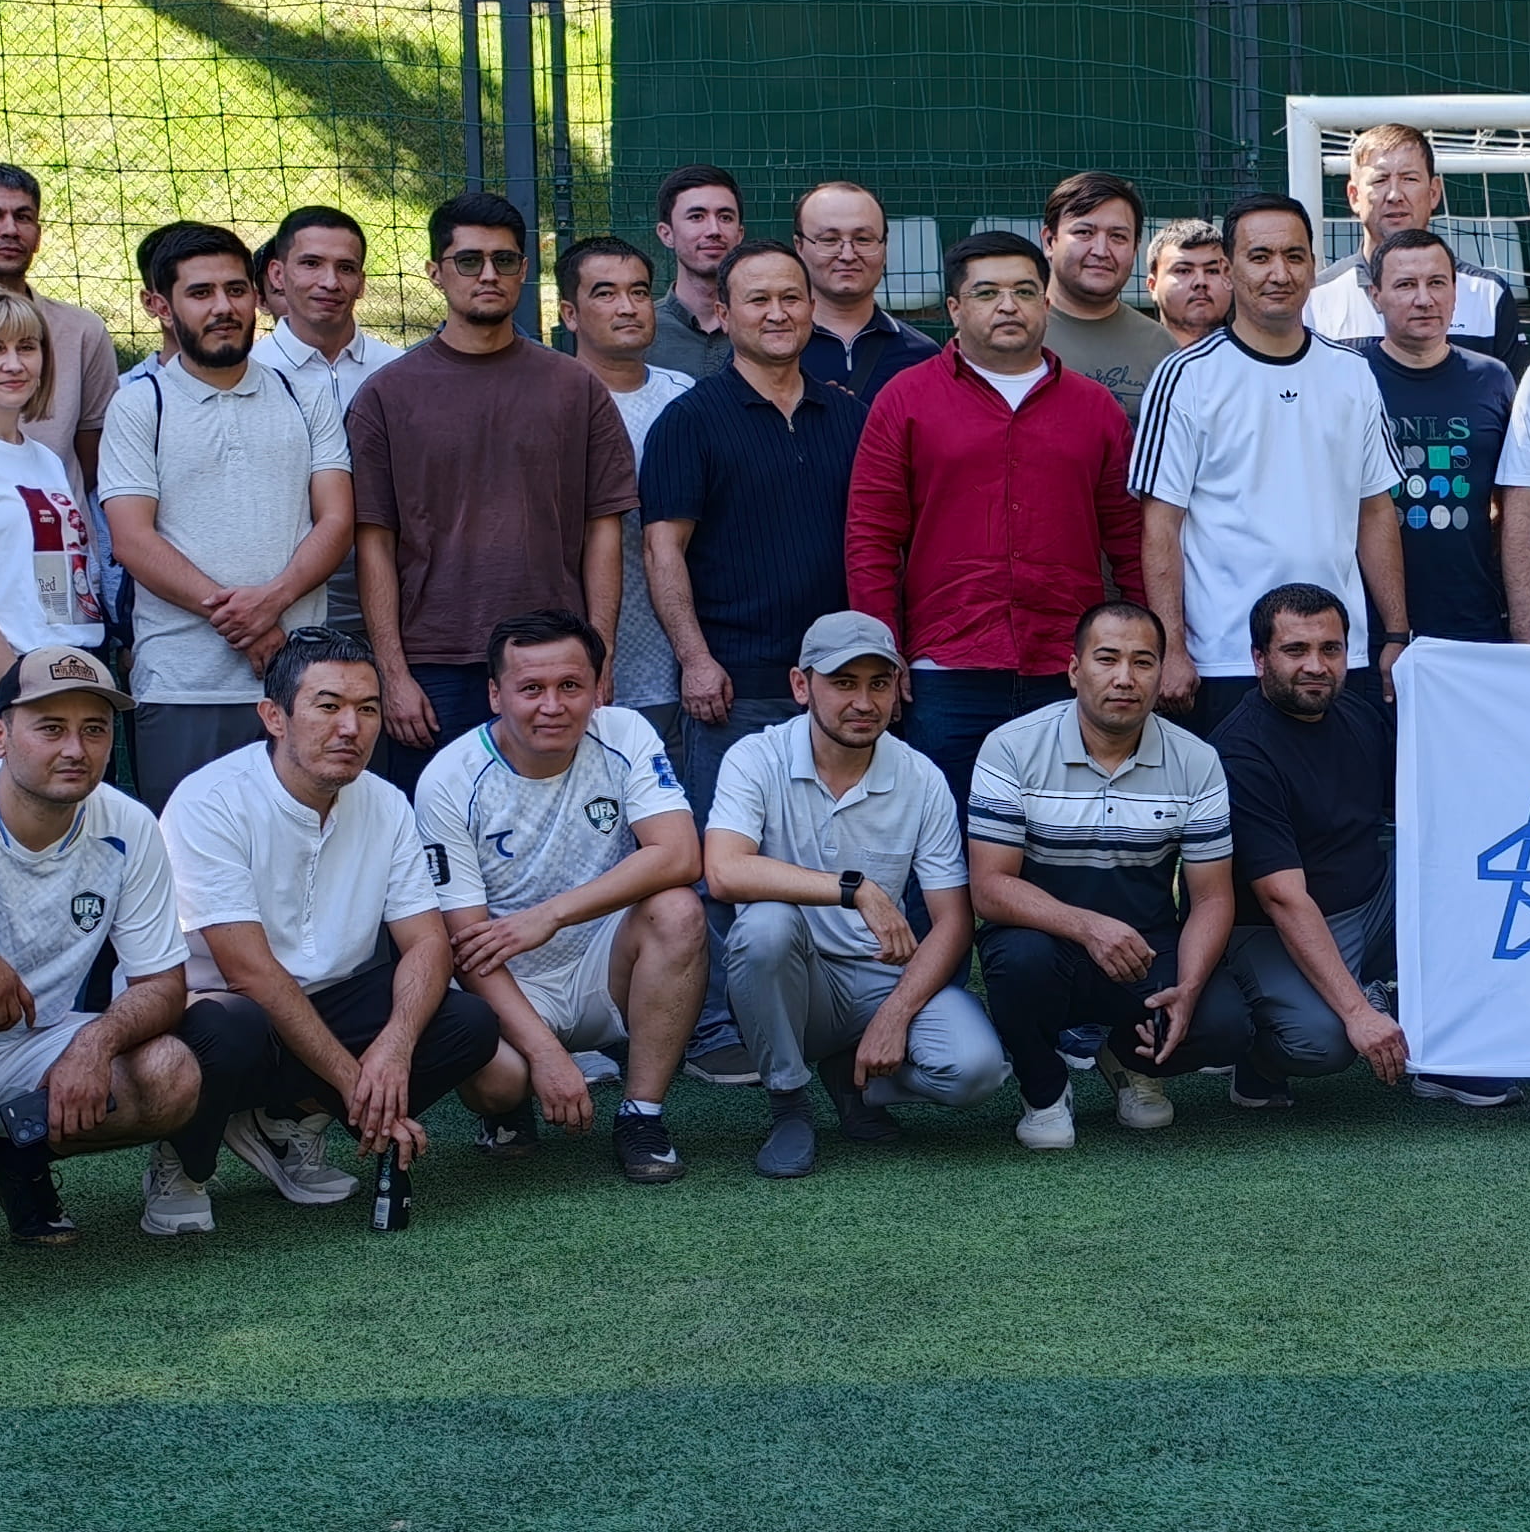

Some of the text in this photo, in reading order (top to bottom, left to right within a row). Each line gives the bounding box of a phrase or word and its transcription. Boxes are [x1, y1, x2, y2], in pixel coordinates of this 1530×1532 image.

[38, 576, 57, 593] Red
[589, 802, 618, 819] UFA
[72, 898, 103, 915] UFA
